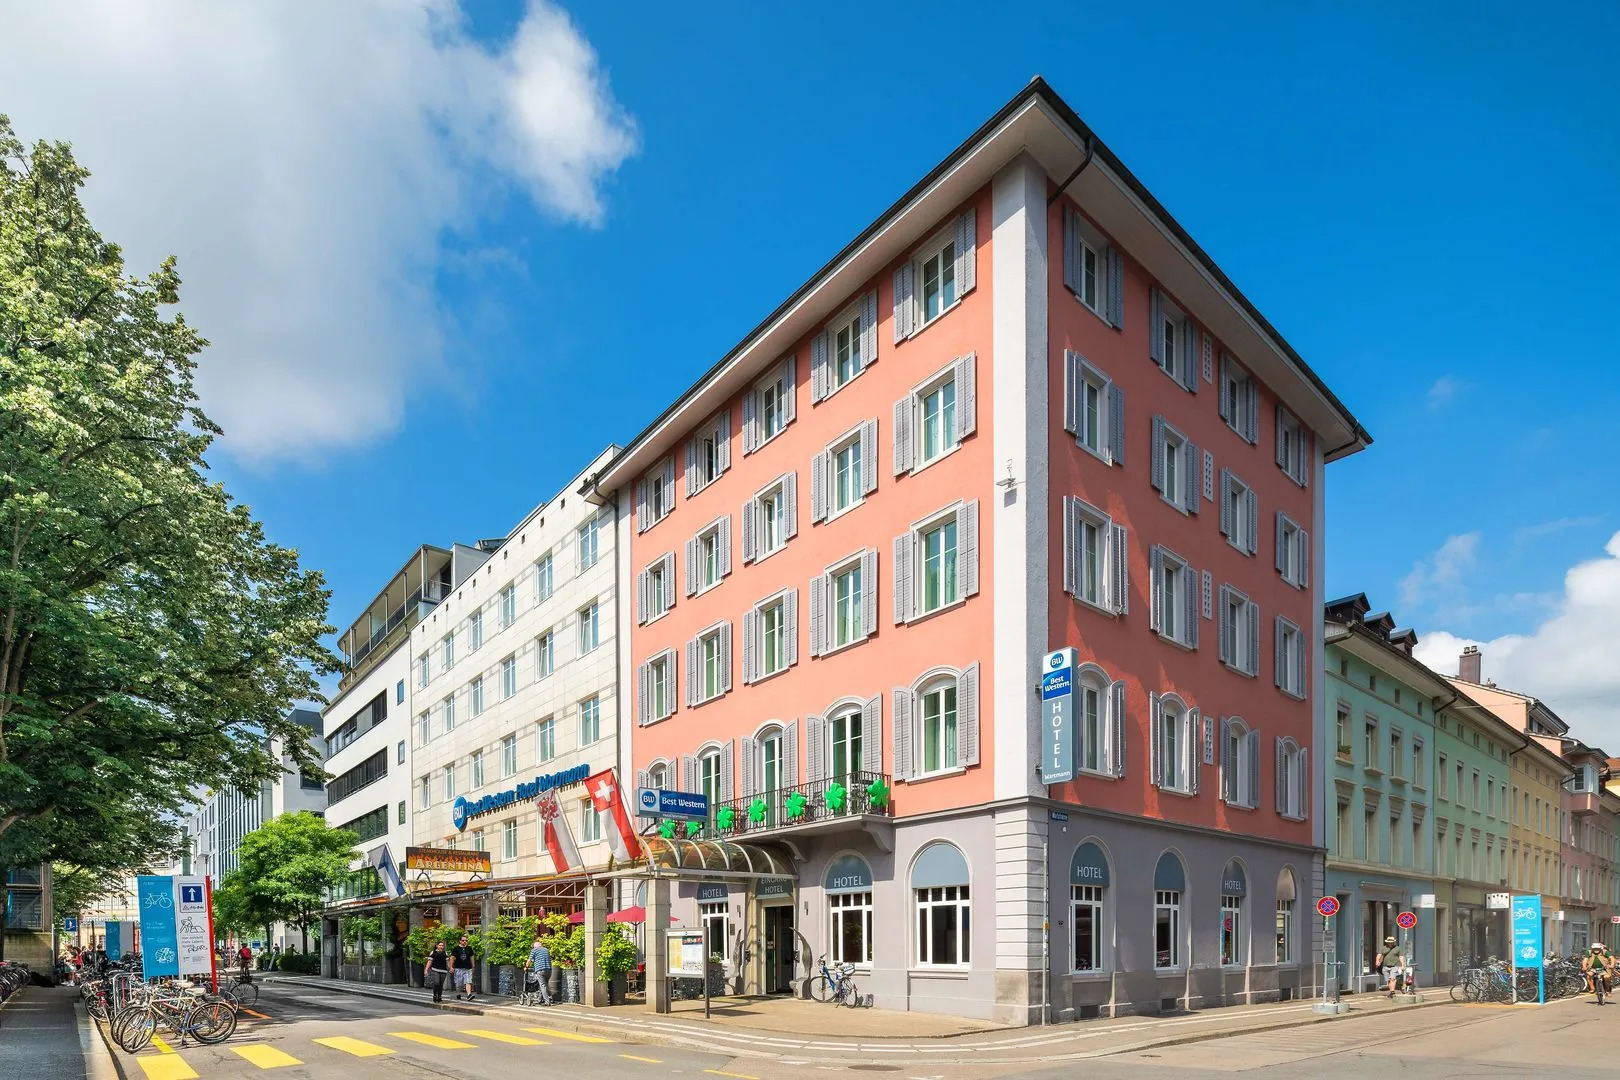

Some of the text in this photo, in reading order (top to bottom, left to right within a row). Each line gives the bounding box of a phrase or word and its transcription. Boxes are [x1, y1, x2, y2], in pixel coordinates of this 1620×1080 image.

[1051, 656, 1063, 666] BW
[1050, 675, 1064, 684] Best
[1044, 681, 1070, 692] Western
[1052, 702, 1062, 769] HOTEL
[482, 790, 515, 812] Western
[516, 776, 539, 800] Hotel
[643, 795, 655, 804] BW
[662, 796, 705, 809] Best Western
[415, 858, 484, 871] ARGENTINA
[1076, 865, 1103, 879] HOTEL
[833, 875, 864, 888] HOTEL
[1224, 879, 1242, 890] HOTEL
[702, 888, 723, 898] HOTEL
[764, 885, 784, 894] HOTEL
